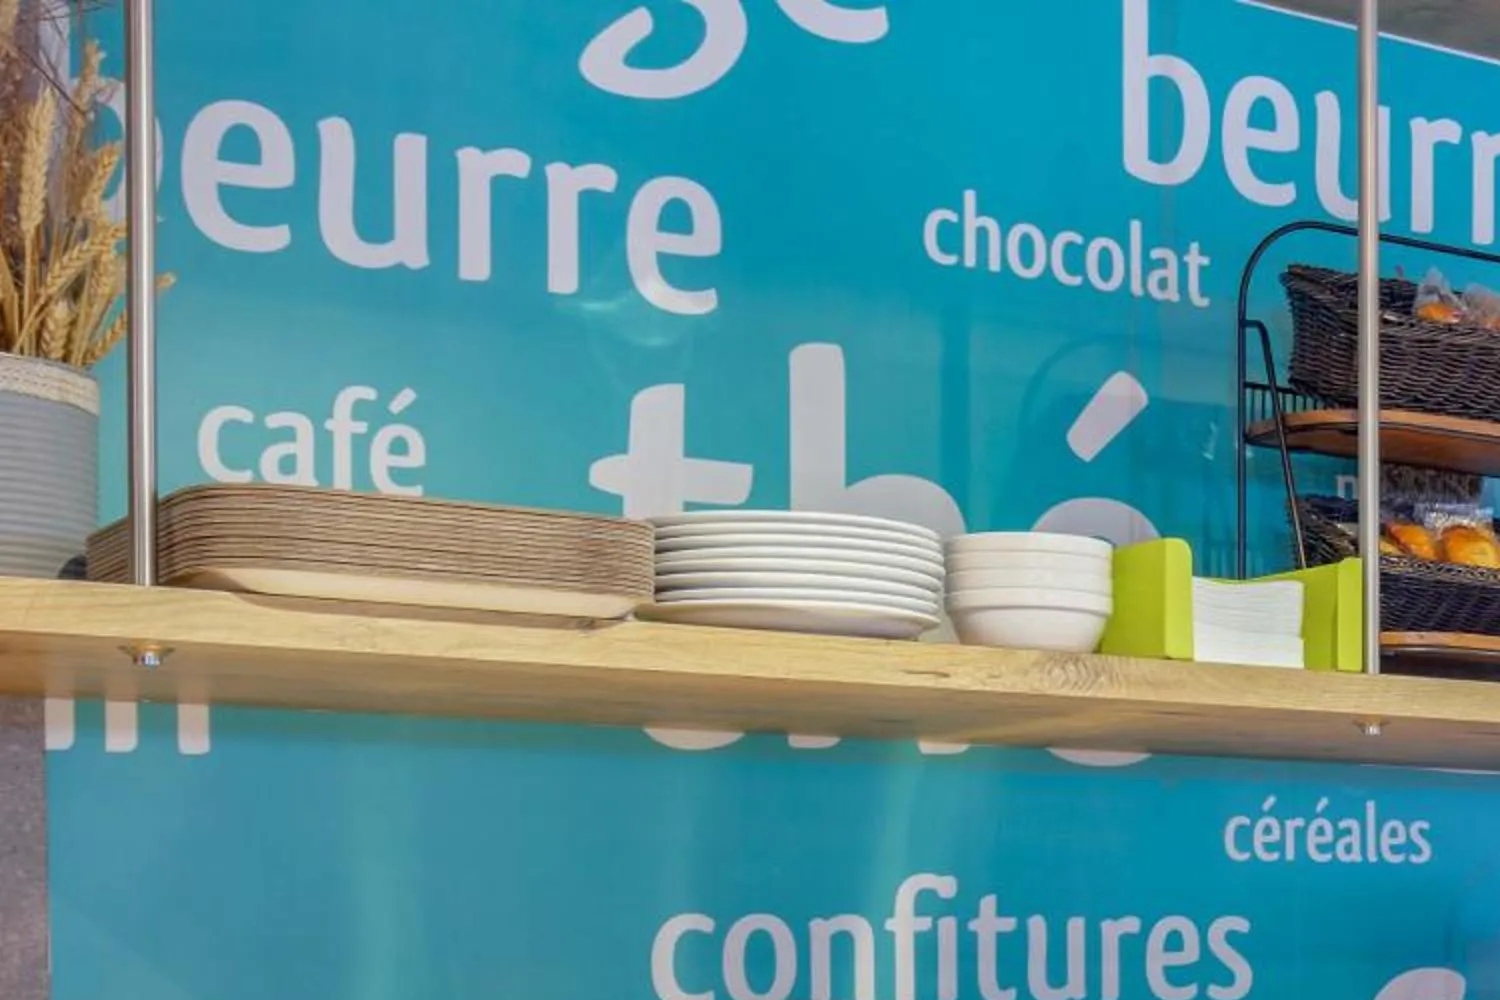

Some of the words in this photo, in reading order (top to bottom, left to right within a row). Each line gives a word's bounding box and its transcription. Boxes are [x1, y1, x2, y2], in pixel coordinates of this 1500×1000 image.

[922, 189, 1211, 309] chocolat
[198, 385, 426, 497] café
[1224, 795, 1432, 865] céréales
